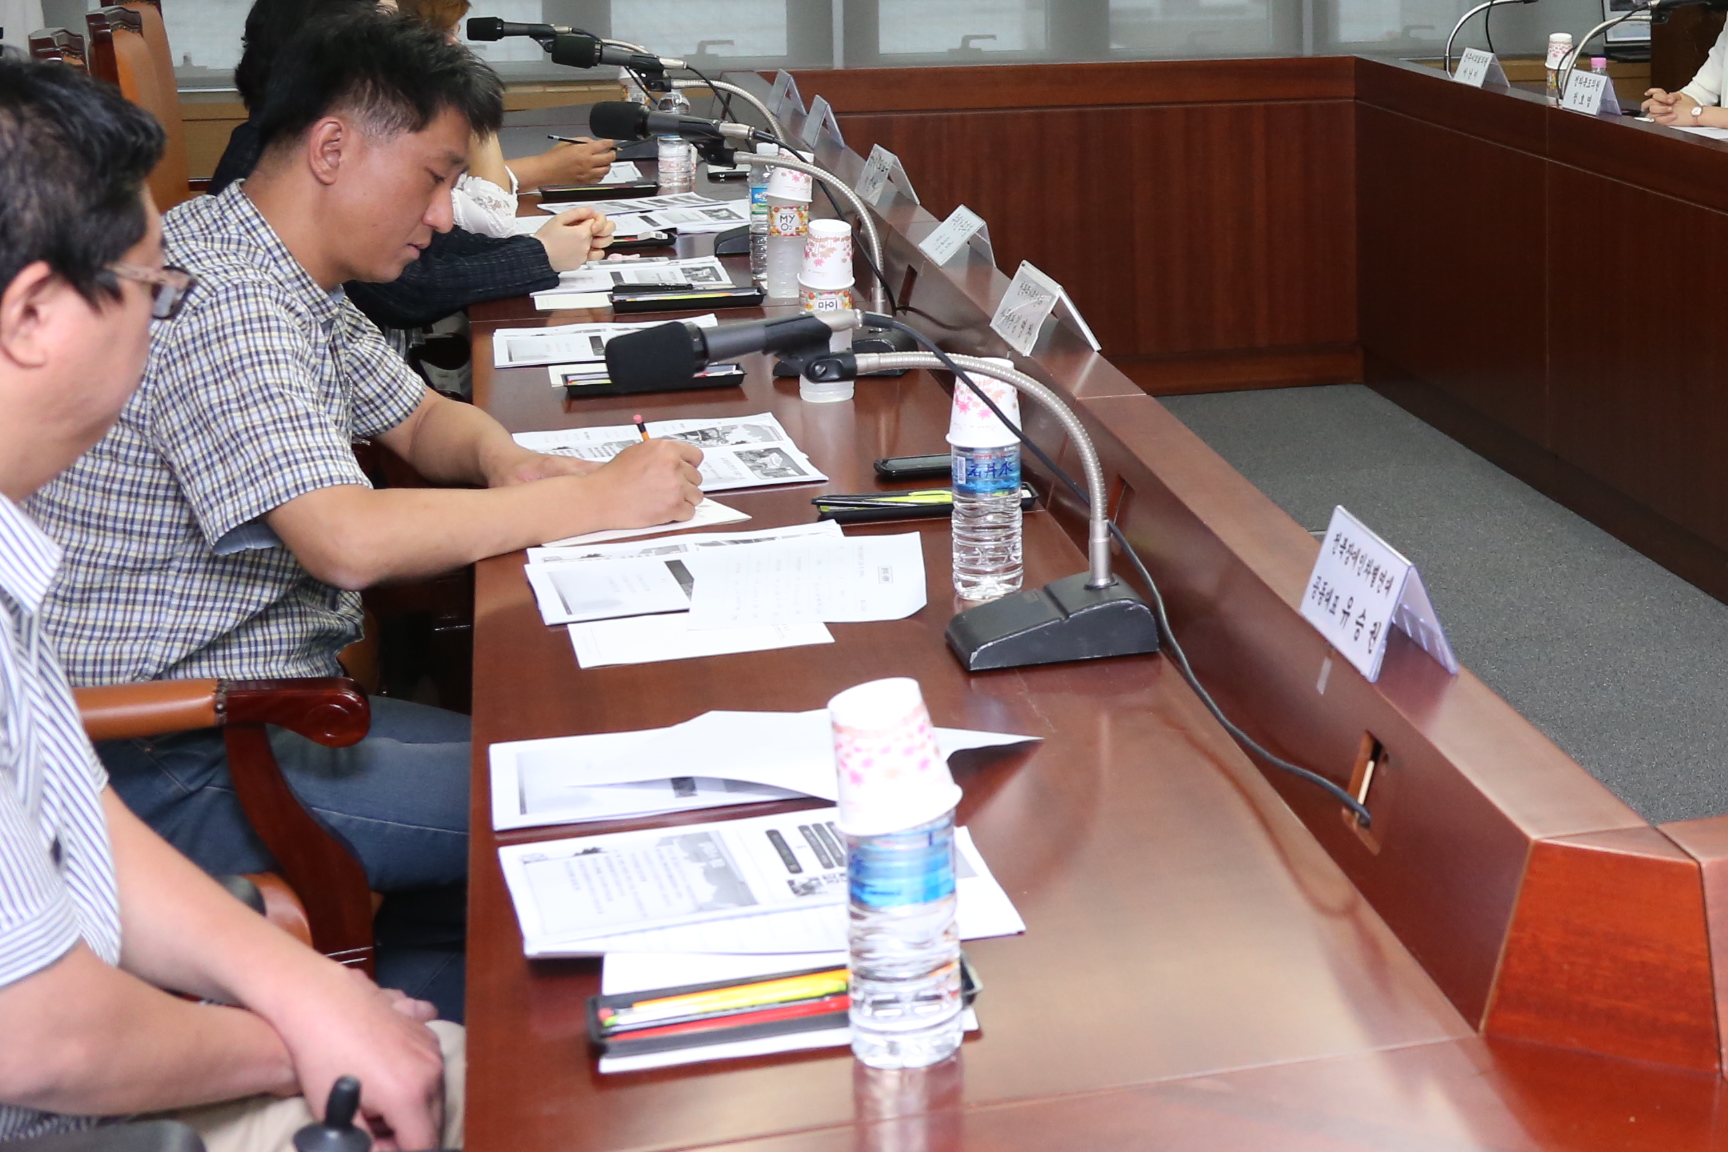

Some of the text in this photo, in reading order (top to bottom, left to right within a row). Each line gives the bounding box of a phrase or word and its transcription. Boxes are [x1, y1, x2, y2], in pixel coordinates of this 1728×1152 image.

[780, 214, 795, 225] MY
[818, 299, 838, 310] 마이
[1311, 575, 1340, 616] 공동대표
